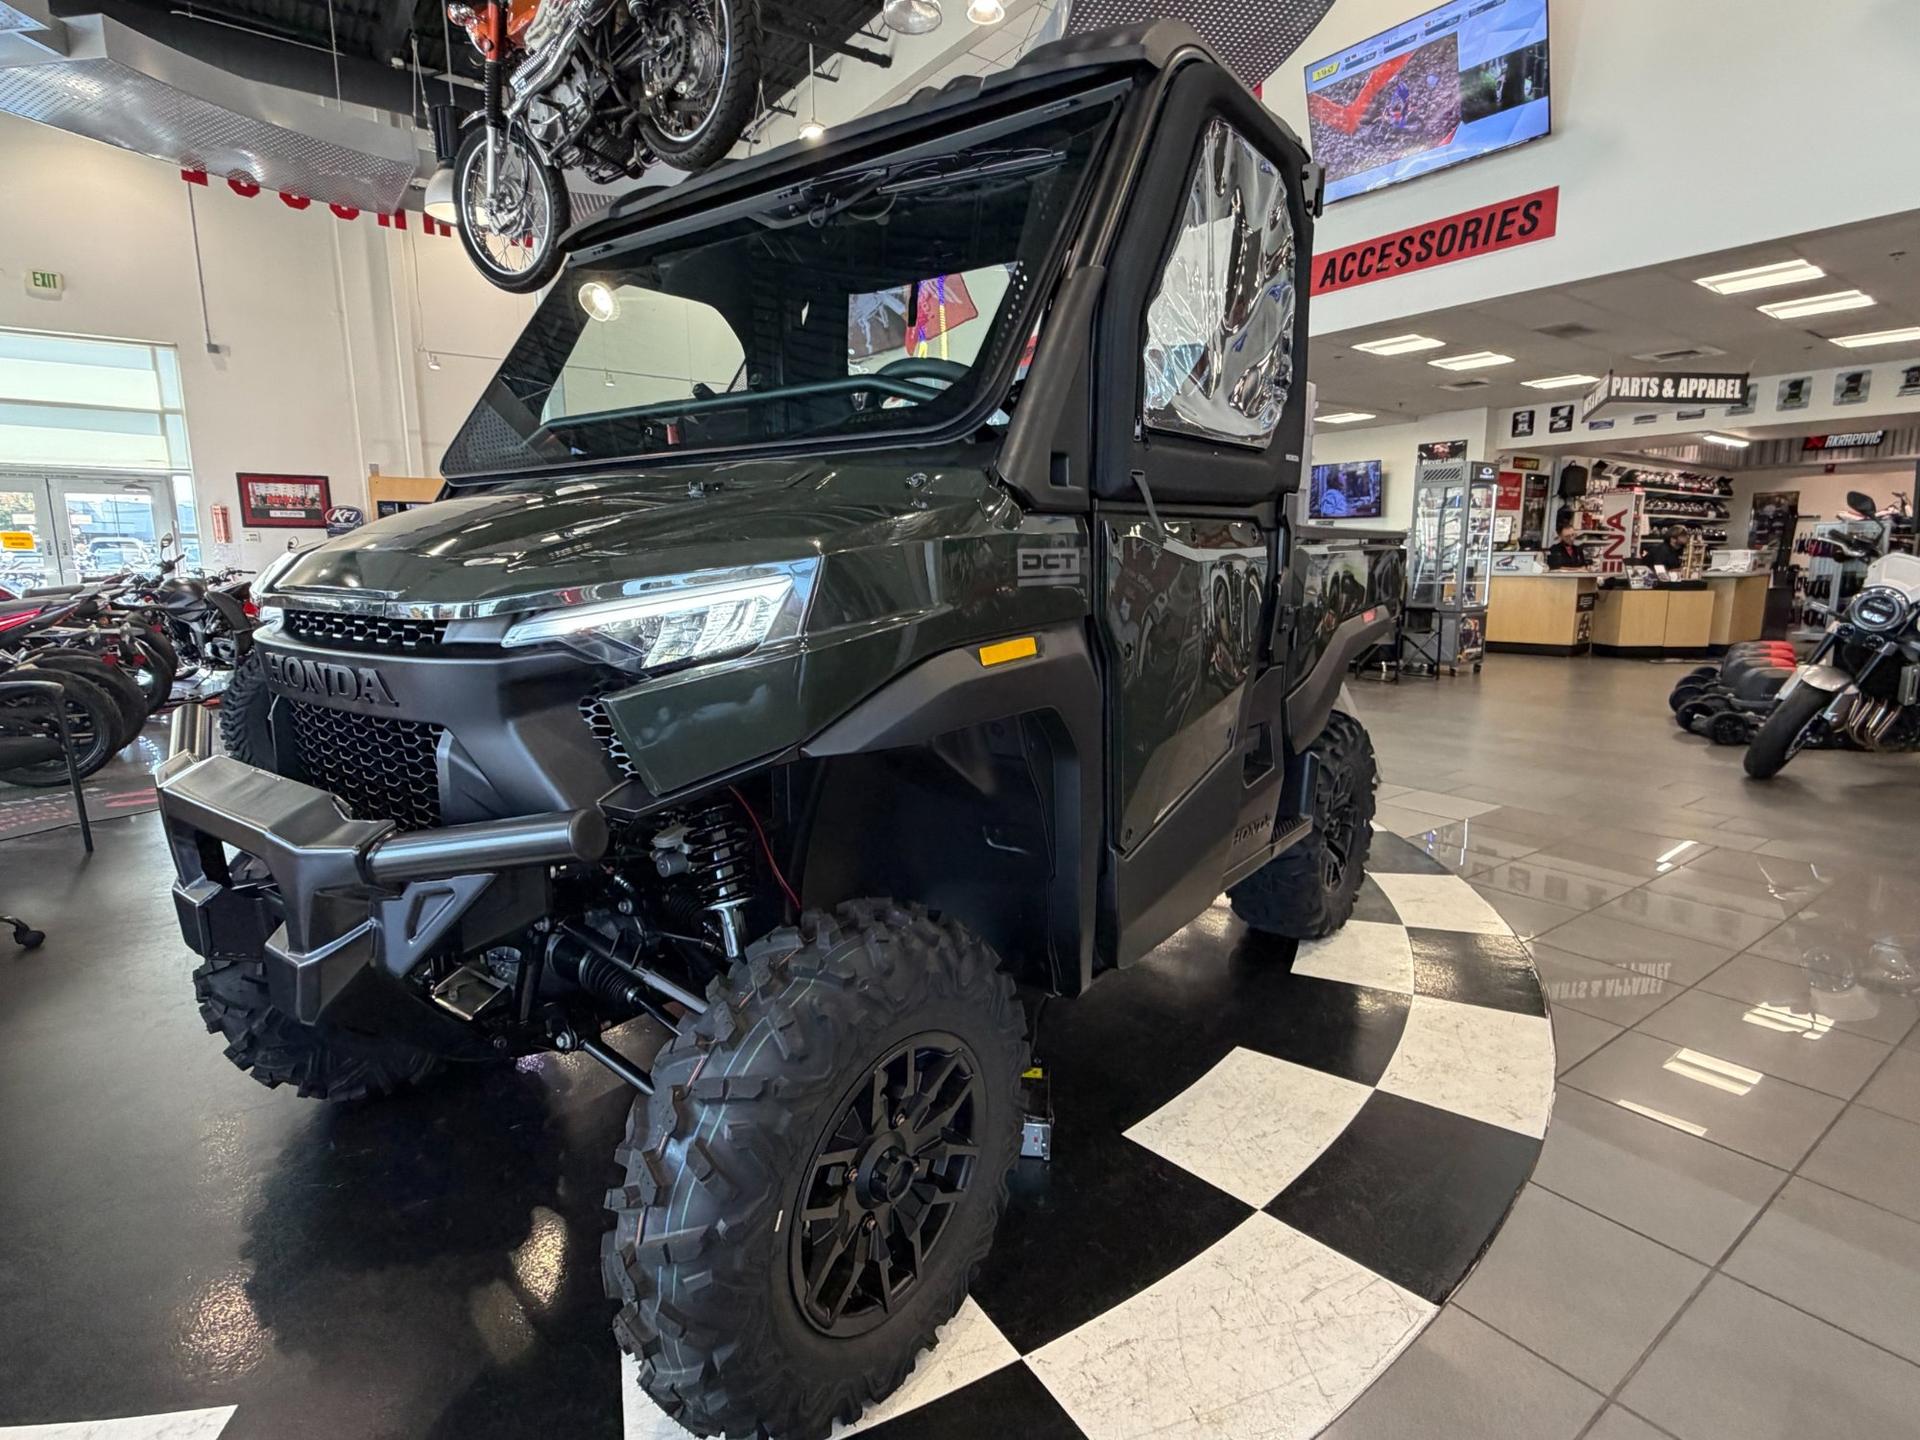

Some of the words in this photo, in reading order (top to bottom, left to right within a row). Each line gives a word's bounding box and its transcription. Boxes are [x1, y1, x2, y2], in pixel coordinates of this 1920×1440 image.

[1319, 200, 1543, 289] ACCESSORIES
[32, 271, 57, 289] EXIT
[1610, 377, 1659, 397] PARTS
[1661, 378, 1675, 398] &
[1677, 378, 1741, 399] APPAREL
[1022, 553, 1076, 571] DCT
[265, 652, 399, 707] HONDA
